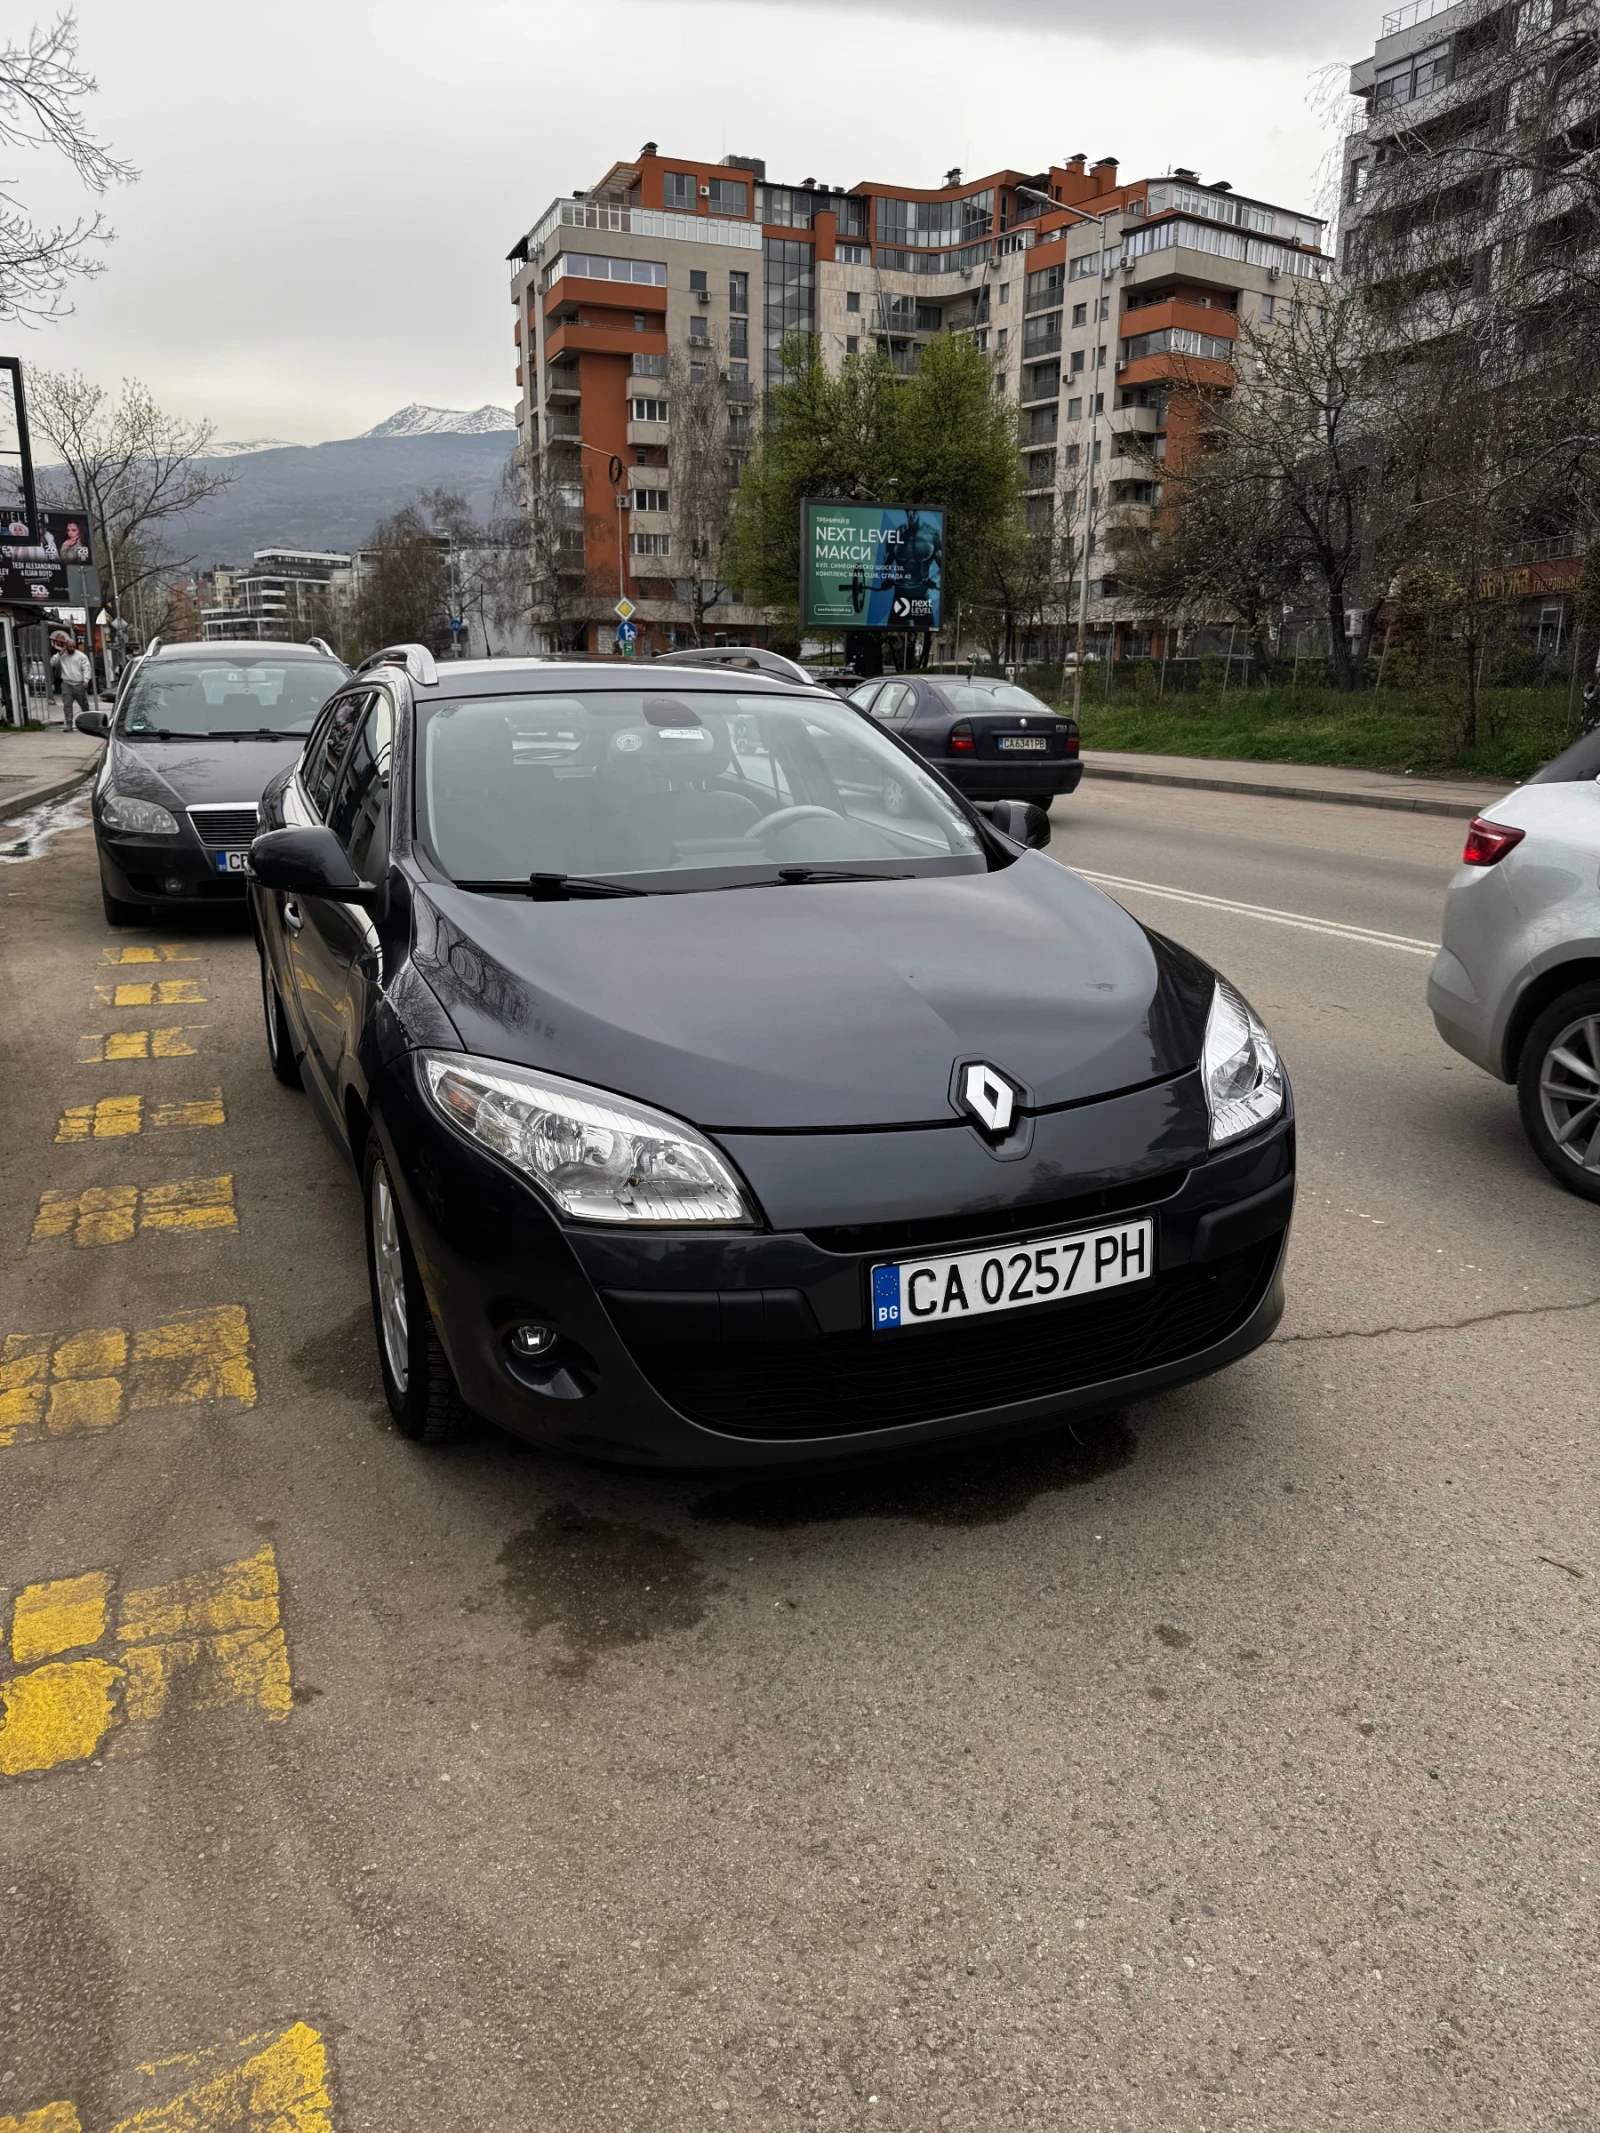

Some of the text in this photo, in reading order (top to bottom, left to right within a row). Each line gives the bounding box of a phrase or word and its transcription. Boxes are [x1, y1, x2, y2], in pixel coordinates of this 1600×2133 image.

[816, 527, 904, 544] NEXT LEVEL
[45, 545, 56, 554] 26
[77, 546, 89, 555] 28
[816, 545, 871, 561] МАКСИ
[25, 562, 61, 571] ALEXANDROVA
[830, 562, 874, 570] СИМЕОНОВСКО
[815, 570, 847, 578] КОМПЛЕКС
[911, 599, 932, 607] next
[907, 1227, 1146, 1317] CA 0257 PH
[878, 1305, 899, 1323] BG
